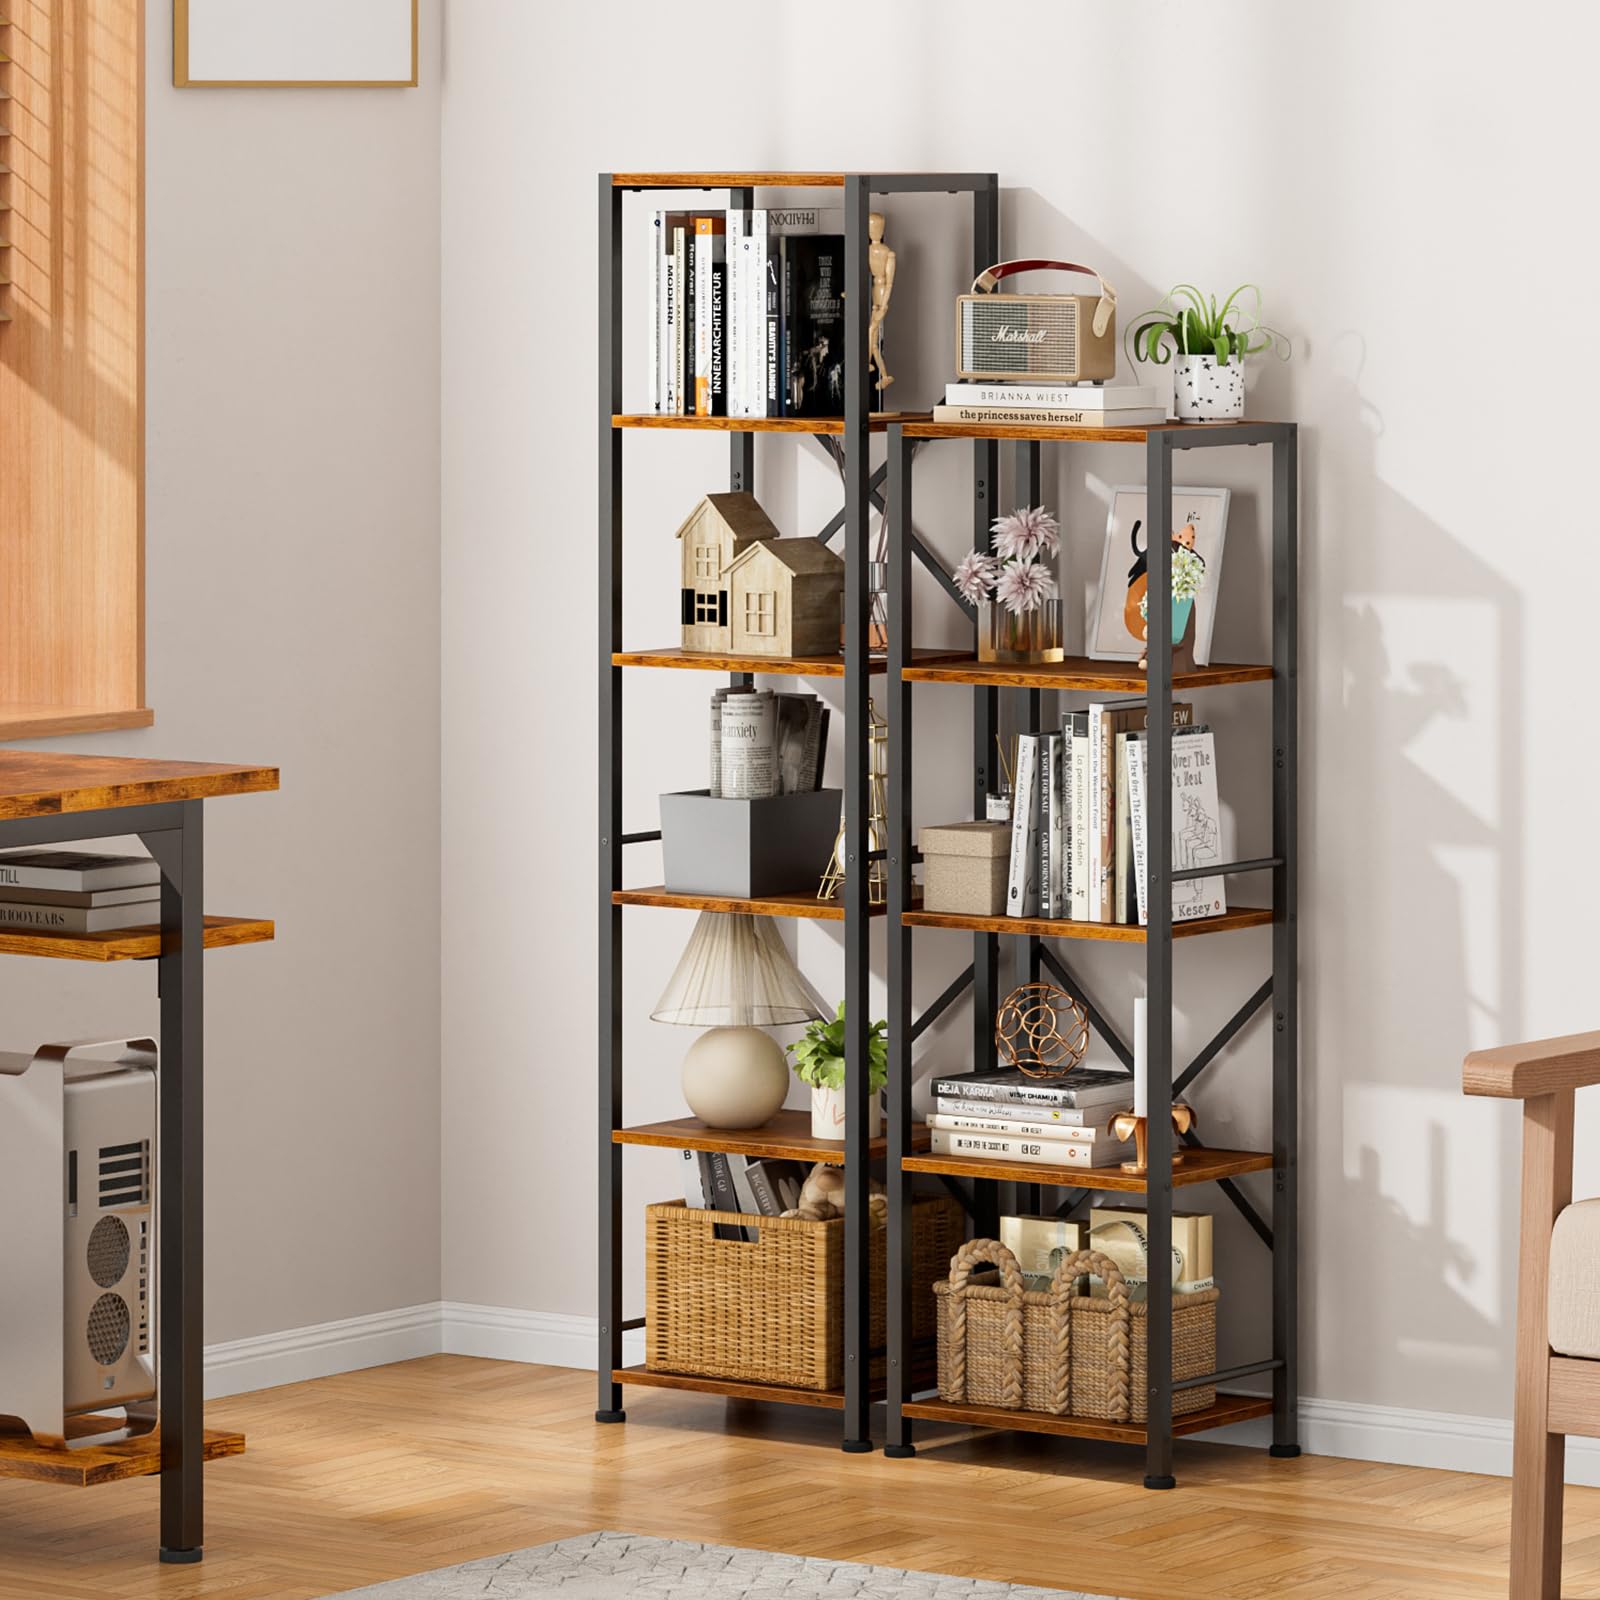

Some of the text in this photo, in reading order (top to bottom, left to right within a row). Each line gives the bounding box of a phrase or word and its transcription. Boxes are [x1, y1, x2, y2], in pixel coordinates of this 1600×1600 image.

[770, 212, 815, 226] PHAIDON
[712, 272, 722, 394] INNENARCHITEKTUR
[992, 325, 1048, 343] Marshall
[768, 321, 776, 400] GRAVITY'S RAINBOW
[981, 391, 1070, 403] BRIANNA WIEST
[960, 410, 1083, 423] the princess saves herself
[1172, 750, 1210, 770] Over The
[1184, 771, 1202, 786] Nest
[1075, 754, 1085, 866] La persistance du destin
[1130, 760, 1138, 777] Flew
[1136, 850, 1144, 866] Nest
[1178, 902, 1210, 917] Kesey
[938, 1082, 960, 1095] DÉJA
[962, 1086, 994, 1098] KARMA
[1028, 1094, 1058, 1102] DHAMIJA
